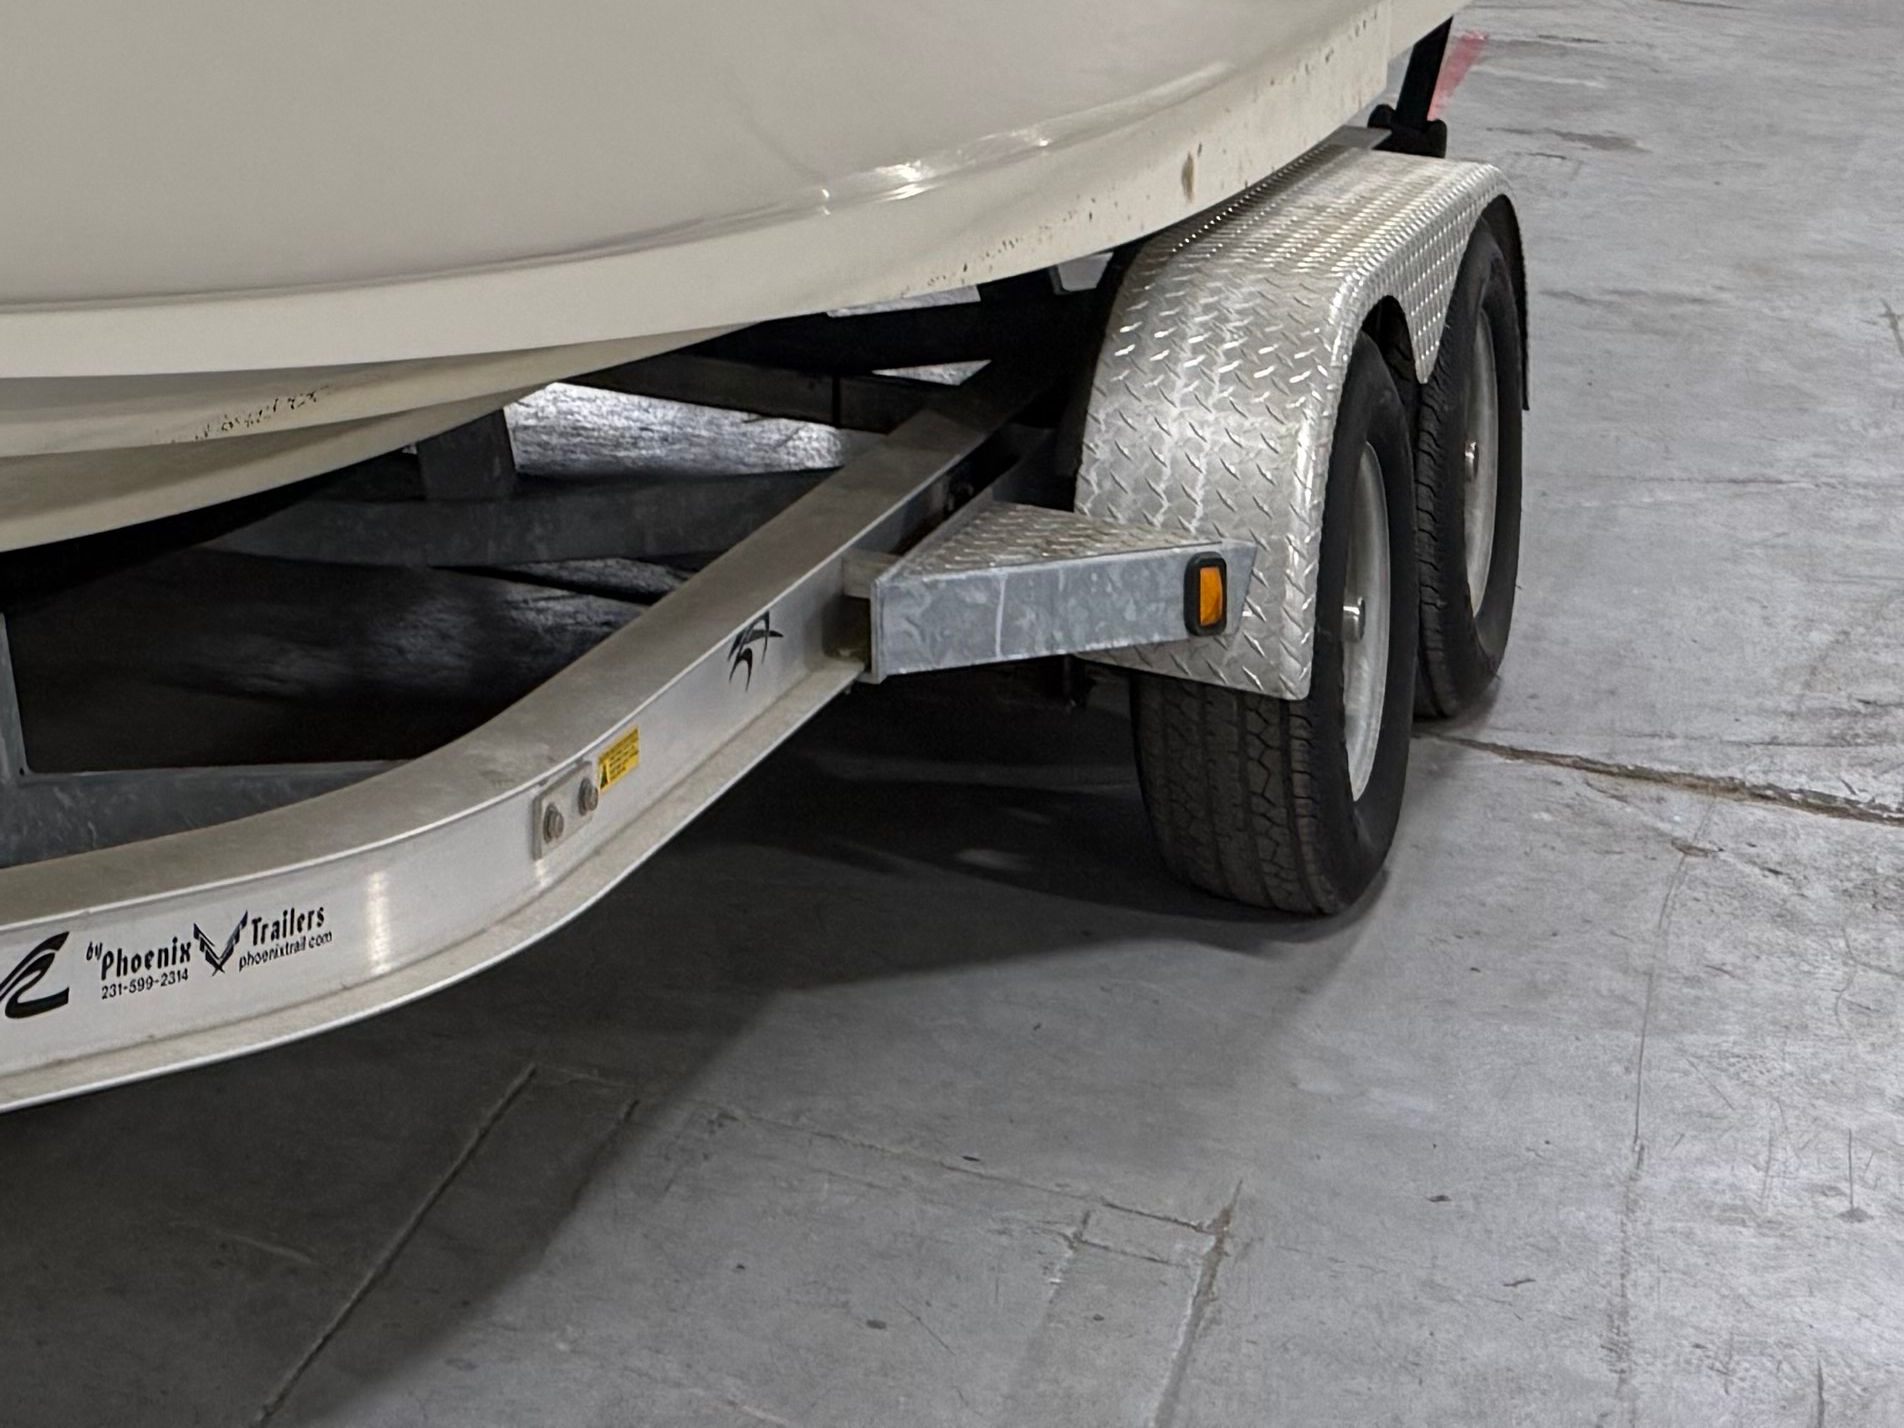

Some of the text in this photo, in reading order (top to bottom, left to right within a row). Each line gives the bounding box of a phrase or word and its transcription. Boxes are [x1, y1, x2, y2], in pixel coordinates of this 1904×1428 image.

[86, 907, 325, 981] by Phoenix Trailers
[101, 967, 189, 1000] 231-599-2314
